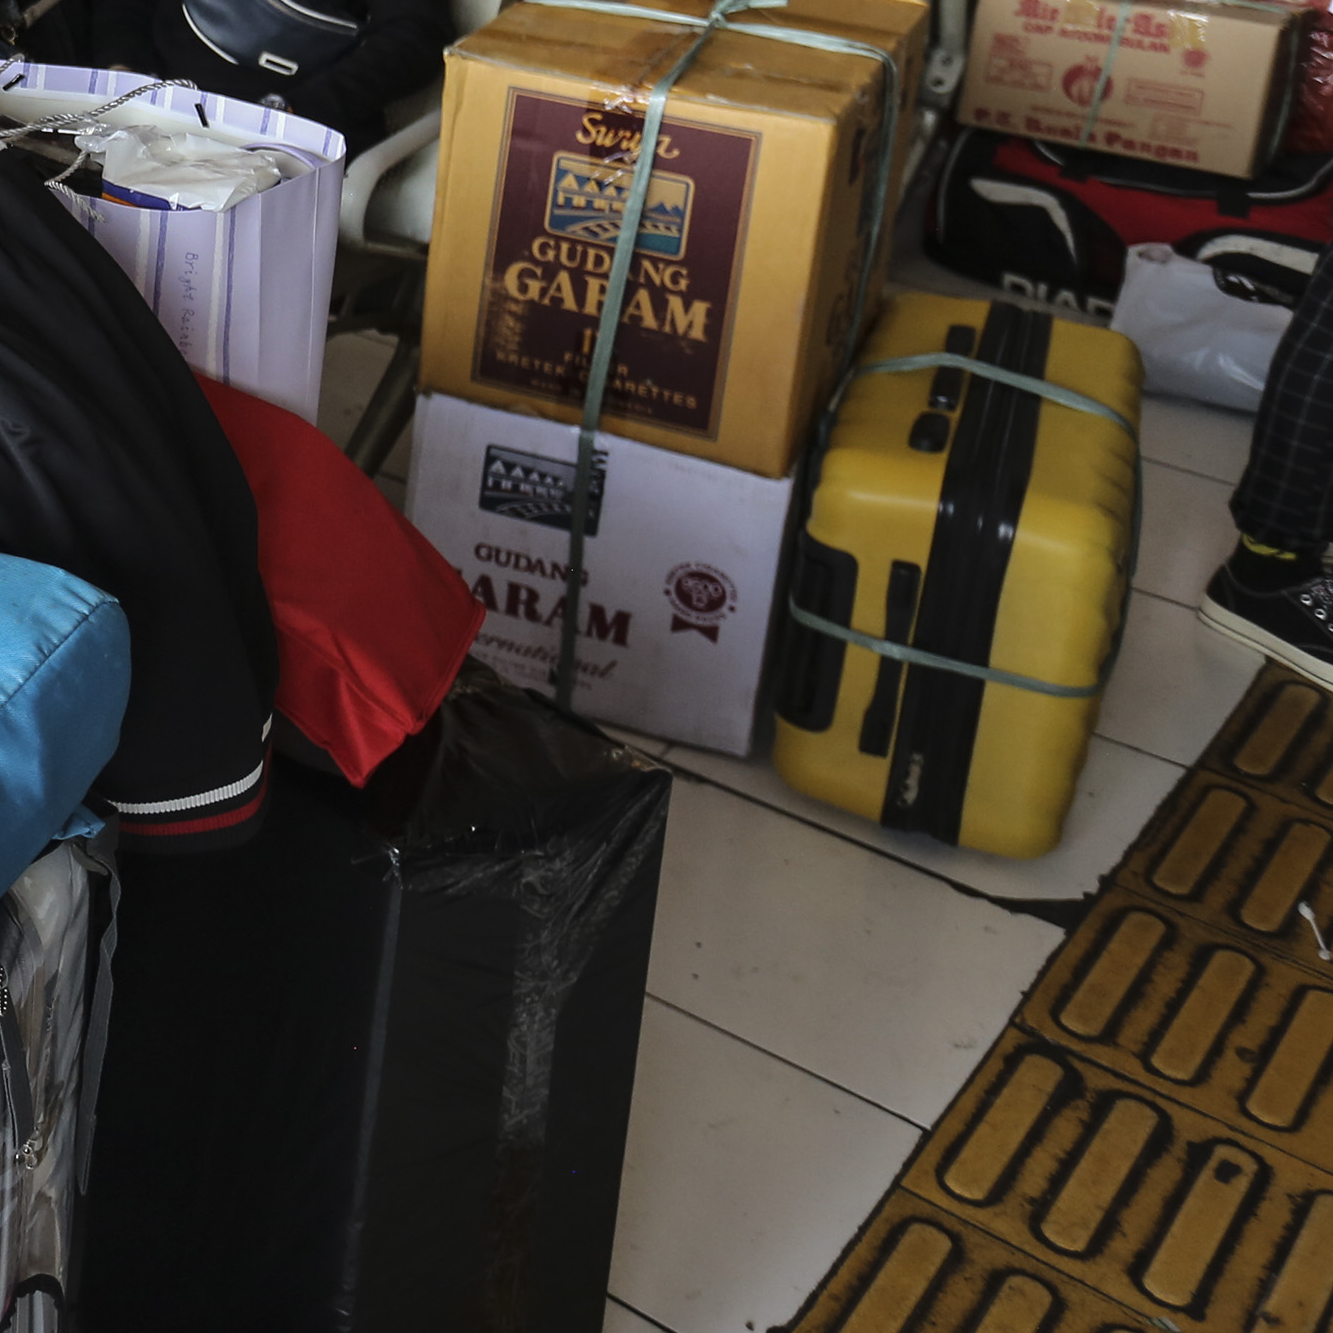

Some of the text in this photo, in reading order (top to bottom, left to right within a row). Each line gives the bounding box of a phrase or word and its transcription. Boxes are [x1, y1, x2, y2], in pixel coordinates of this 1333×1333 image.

[531, 236, 691, 293] GUDNG
[502, 260, 714, 344] GARAM
[563, 351, 629, 377] FILR
[579, 370, 699, 411] CARETTES
[470, 572, 633, 649] ARAM
